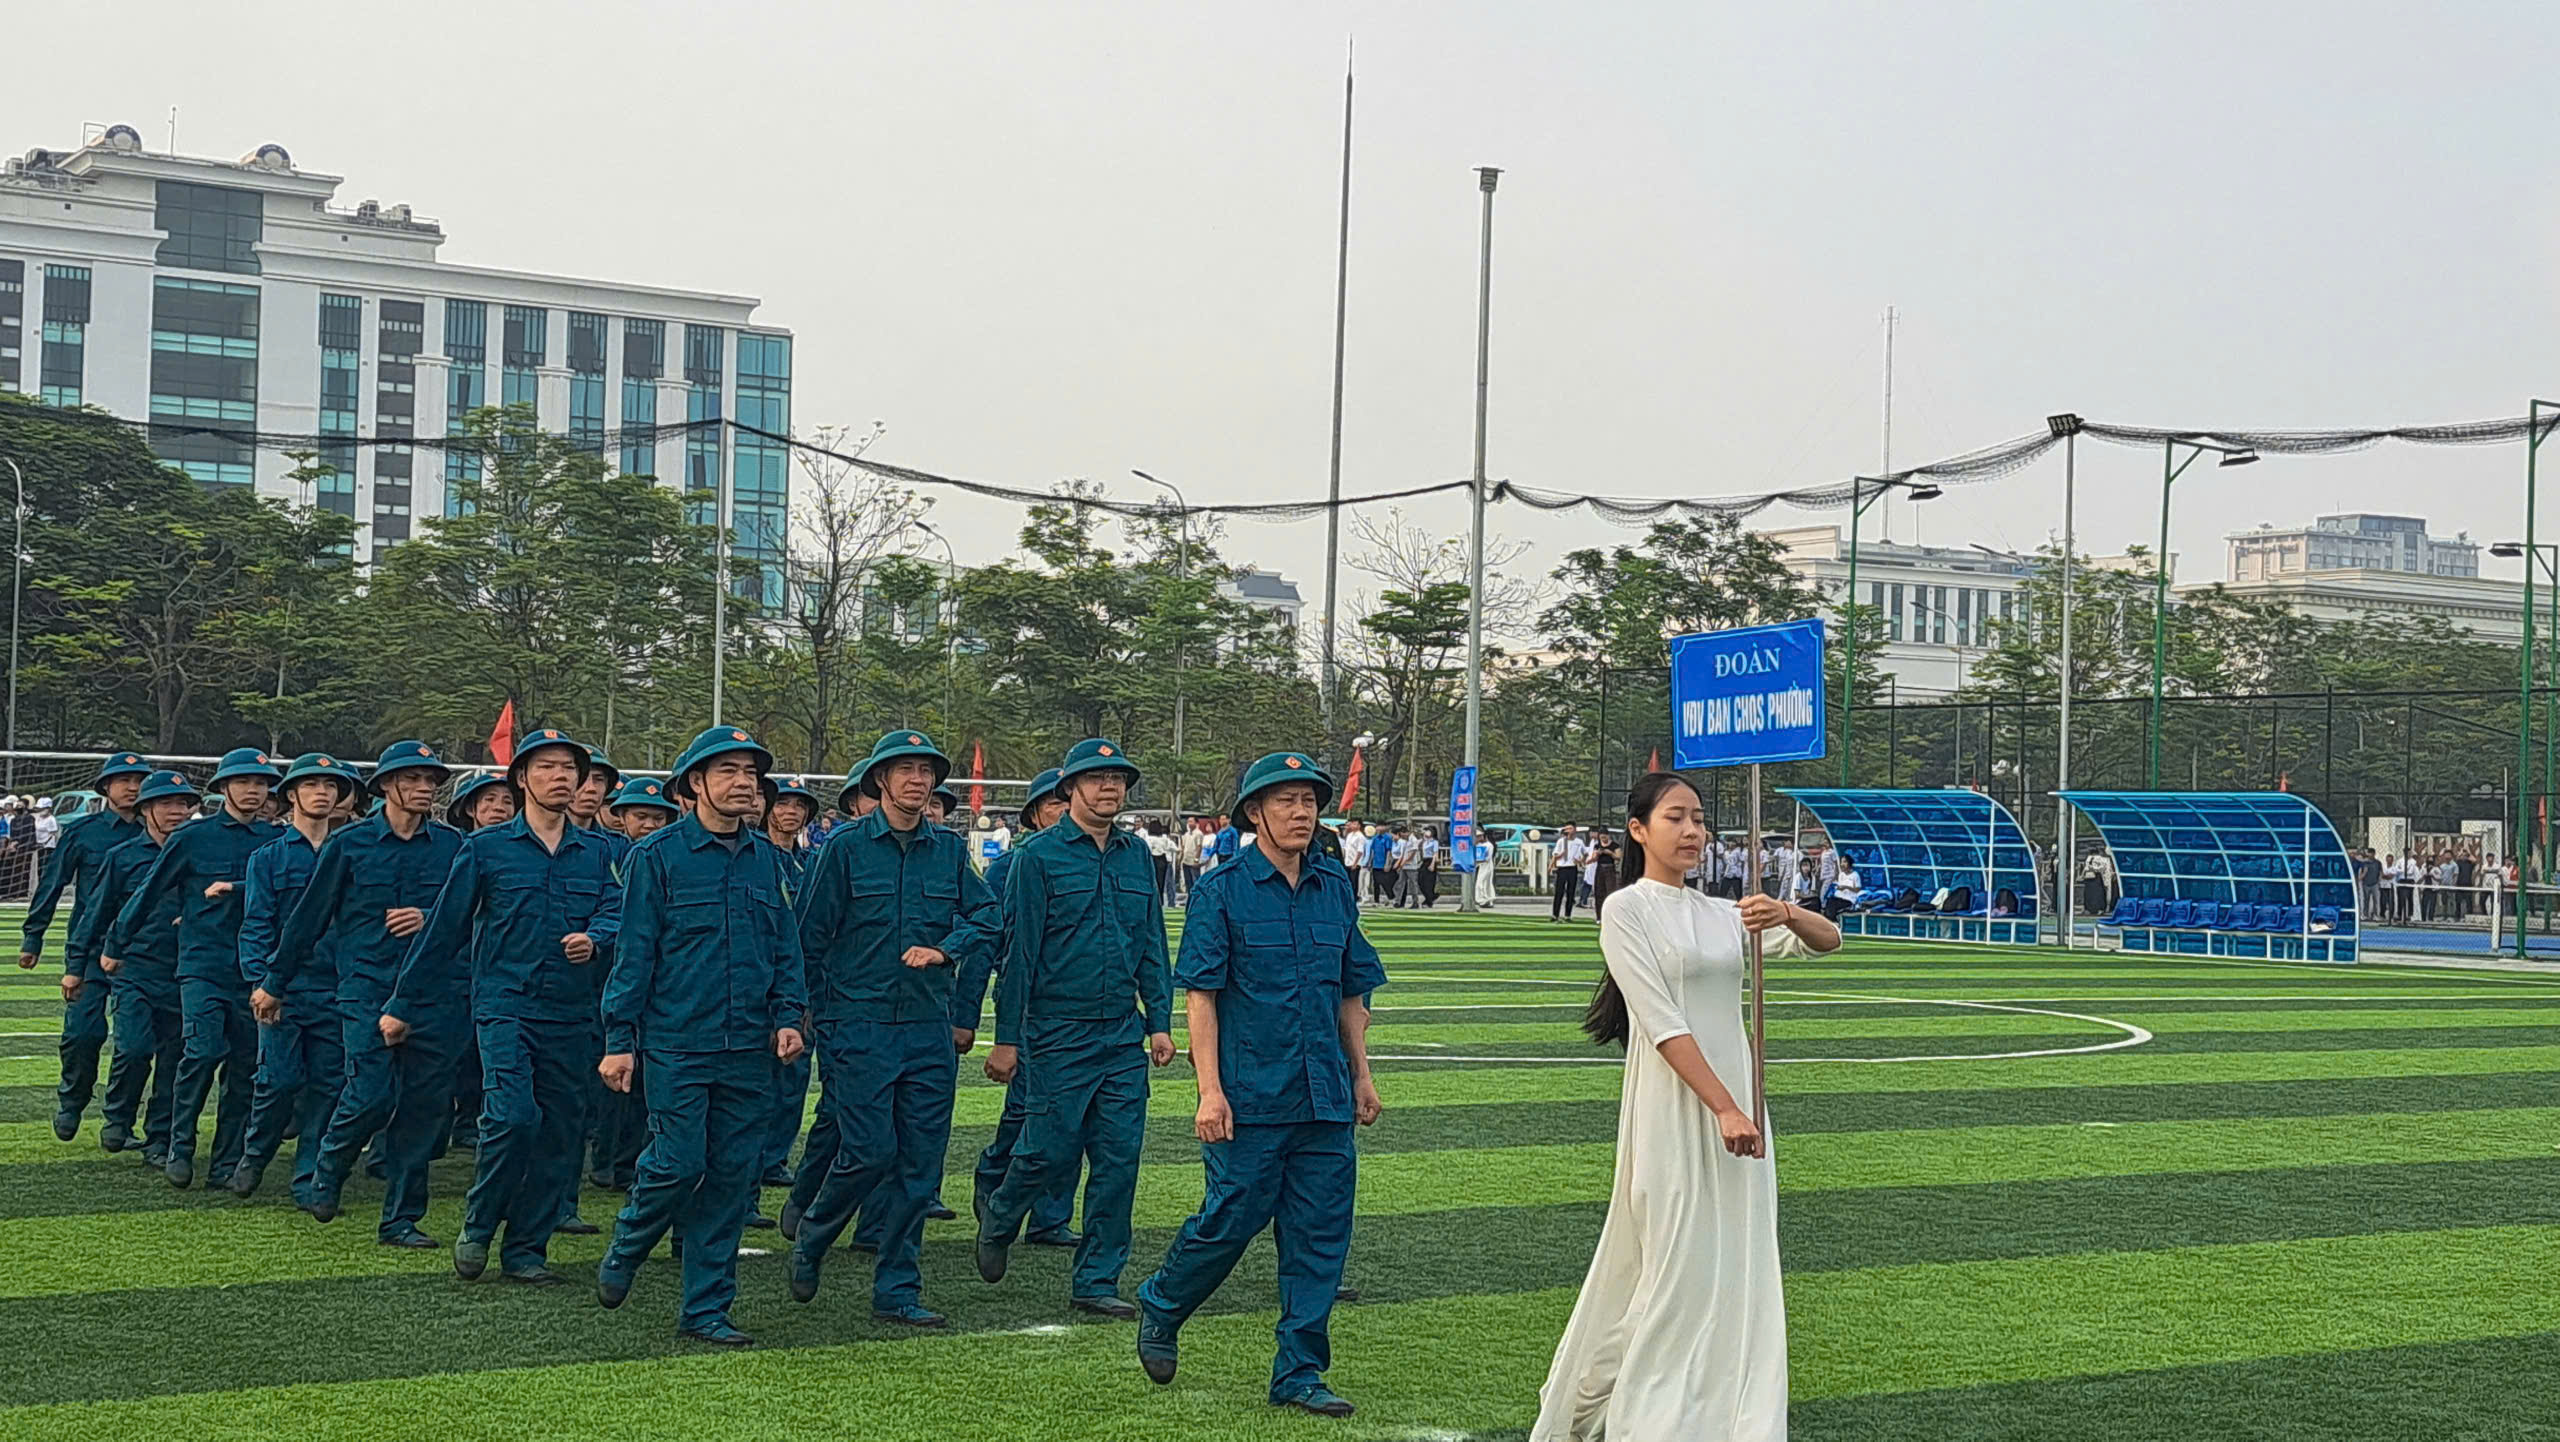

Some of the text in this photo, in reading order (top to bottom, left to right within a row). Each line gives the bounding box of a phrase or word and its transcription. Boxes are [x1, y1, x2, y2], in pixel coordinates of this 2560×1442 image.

[1715, 642, 1781, 678] ĐOÀN
[1707, 697, 1731, 736] BAN
[1733, 694, 1764, 736] CHQS
[1767, 680, 1813, 730] PHƯỜNG
